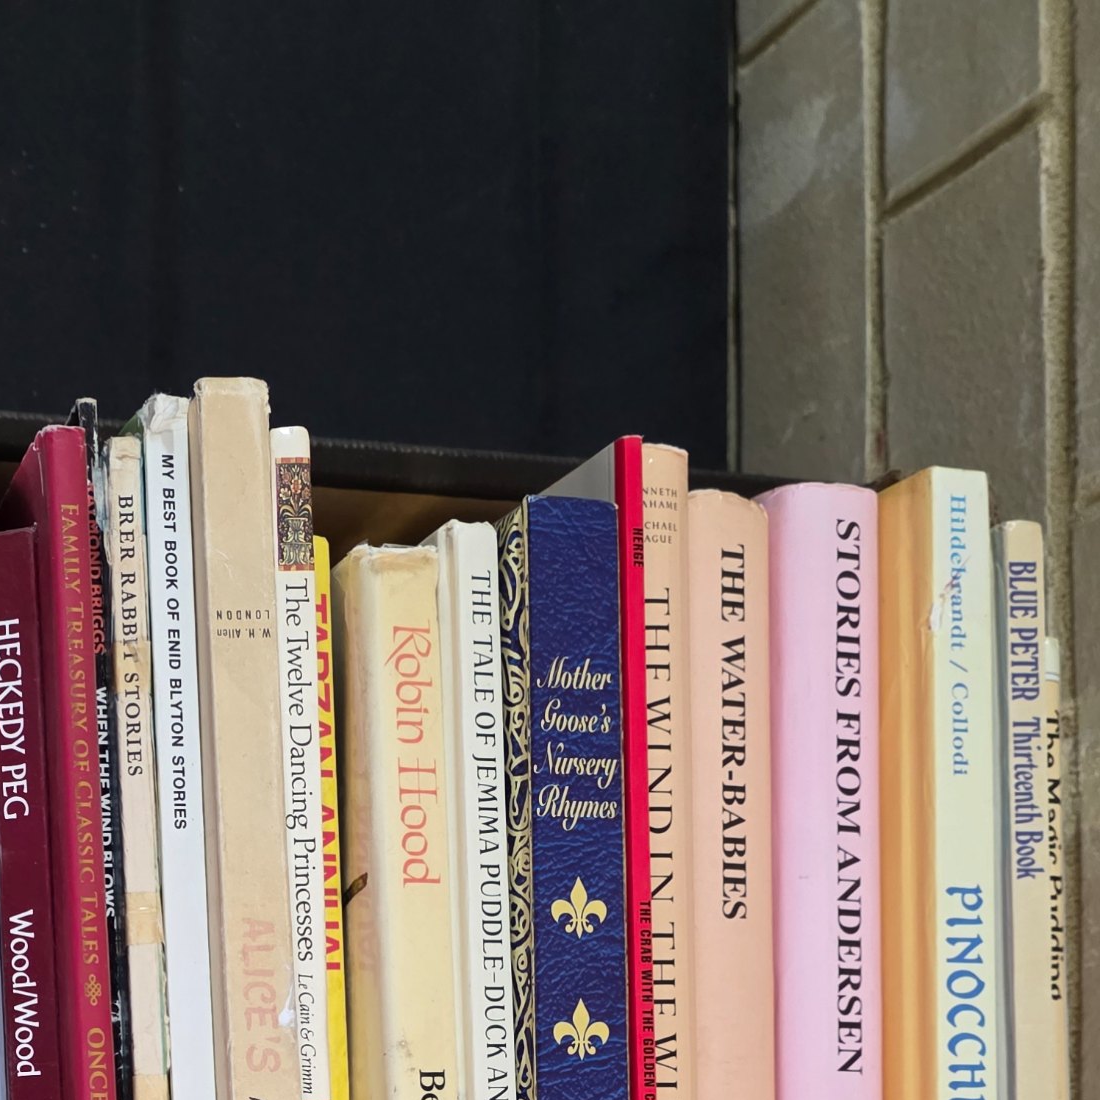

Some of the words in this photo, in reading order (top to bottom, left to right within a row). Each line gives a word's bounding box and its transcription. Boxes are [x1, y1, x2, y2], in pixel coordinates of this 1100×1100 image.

[161, 454, 175, 481] MY
[117, 494, 137, 562] BRER
[162, 487, 176, 531] BEST
[60, 503, 86, 594] FAMILY
[164, 540, 179, 590] BOOK
[948, 495, 968, 652] Hildebrandt
[166, 598, 180, 622] OF
[214, 609, 271, 620] LONDON
[284, 577, 310, 627] The
[470, 569, 492, 626] THE
[720, 544, 746, 623] THE
[834, 518, 862, 698] STORIES
[1008, 560, 1039, 619] BLUE
[119, 571, 141, 661] RABBIT
[216, 627, 242, 640] Allen
[644, 587, 671, 683] THE
[64, 601, 90, 732] TREASURY
[167, 629, 183, 671] ENID
[286, 631, 312, 717] Twelve
[384, 618, 433, 745] Robin
[471, 633, 495, 702] TALE
[536, 655, 612, 691] Mother
[1010, 627, 1041, 701] PETER
[95, 687, 109, 746] WHEN
[123, 672, 144, 778] STORIES
[168, 678, 185, 747] BLYTON
[474, 711, 497, 747] OF
[540, 697, 612, 734] Goose's
[950, 682, 970, 776] Collodi
[71, 739, 92, 773] OF
[98, 750, 110, 789] THE
[284, 724, 314, 830] Dancing
[533, 741, 619, 790] Nursery
[645, 694, 674, 835] WIND
[721, 636, 748, 920] WATER-BABIES
[834, 707, 862, 836] FROM
[1012, 716, 1043, 825] Thirteenth
[0, 762, 30, 820] PEG
[101, 793, 113, 846] WIND
[171, 755, 188, 831] STORIES
[397, 756, 443, 889] Hood
[471, 753, 501, 855] JEMIMA
[536, 783, 618, 832] Rhymes
[74, 779, 96, 884] CLASSIC
[1014, 830, 1045, 880] Book
[292, 838, 317, 962] Princesses
[648, 851, 675, 903] IN
[79, 891, 100, 965] TALES
[639, 899, 651, 925] THE
[479, 862, 509, 1058] PUDDLE-DUCK
[640, 928, 652, 963] CRAB
[652, 923, 677, 1018] THE
[835, 843, 864, 1075] ANDERSEN
[8, 908, 42, 1078] Wood/Wood
[238, 917, 281, 1075] ALICE'S
[297, 973, 313, 989] Le
[298, 992, 315, 1025] Cain
[641, 968, 654, 1001] WITH
[298, 1027, 315, 1042] &
[642, 1007, 654, 1032] THE
[300, 1043, 318, 1095] Grimm
[643, 1037, 657, 1088] GOLDEN
